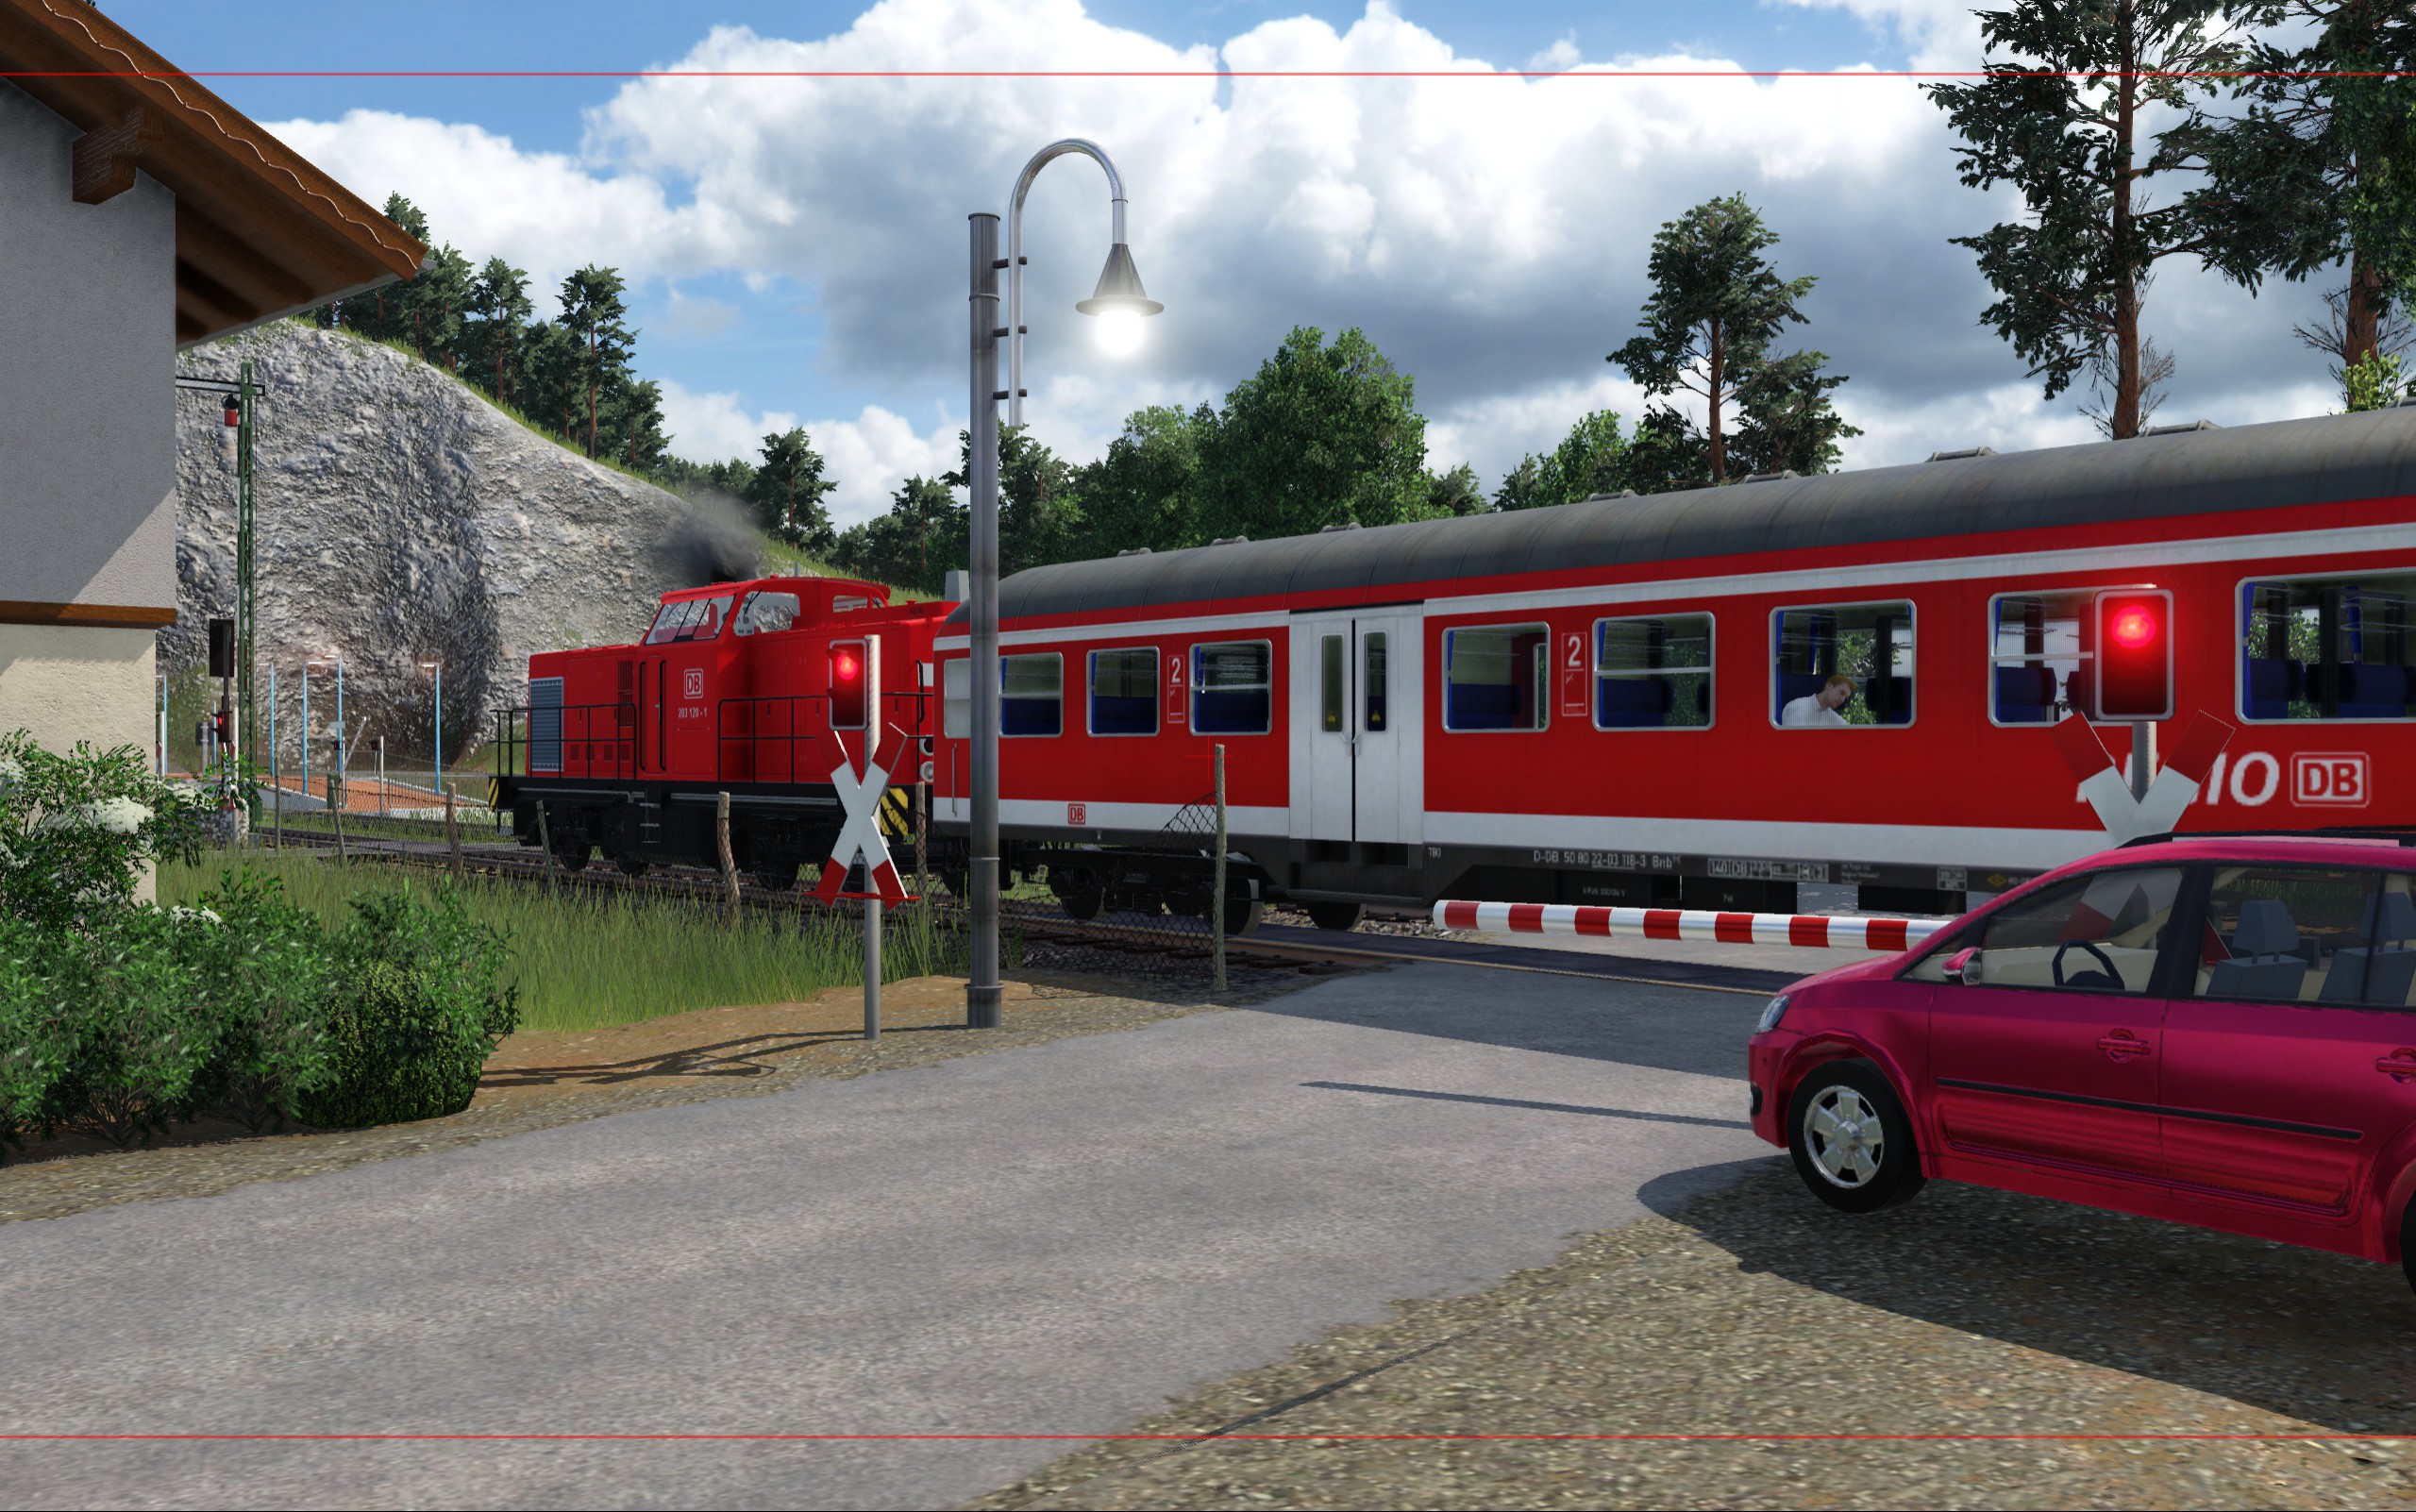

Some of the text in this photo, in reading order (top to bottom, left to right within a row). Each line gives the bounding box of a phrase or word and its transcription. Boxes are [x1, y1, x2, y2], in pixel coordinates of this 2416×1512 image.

[1568, 635, 1582, 666] 2
[1171, 657, 1181, 683] 2
[686, 673, 701, 695] DB
[2300, 761, 2360, 800] DB
[1069, 806, 1084, 822] DB
[1564, 851, 1575, 865] 50
